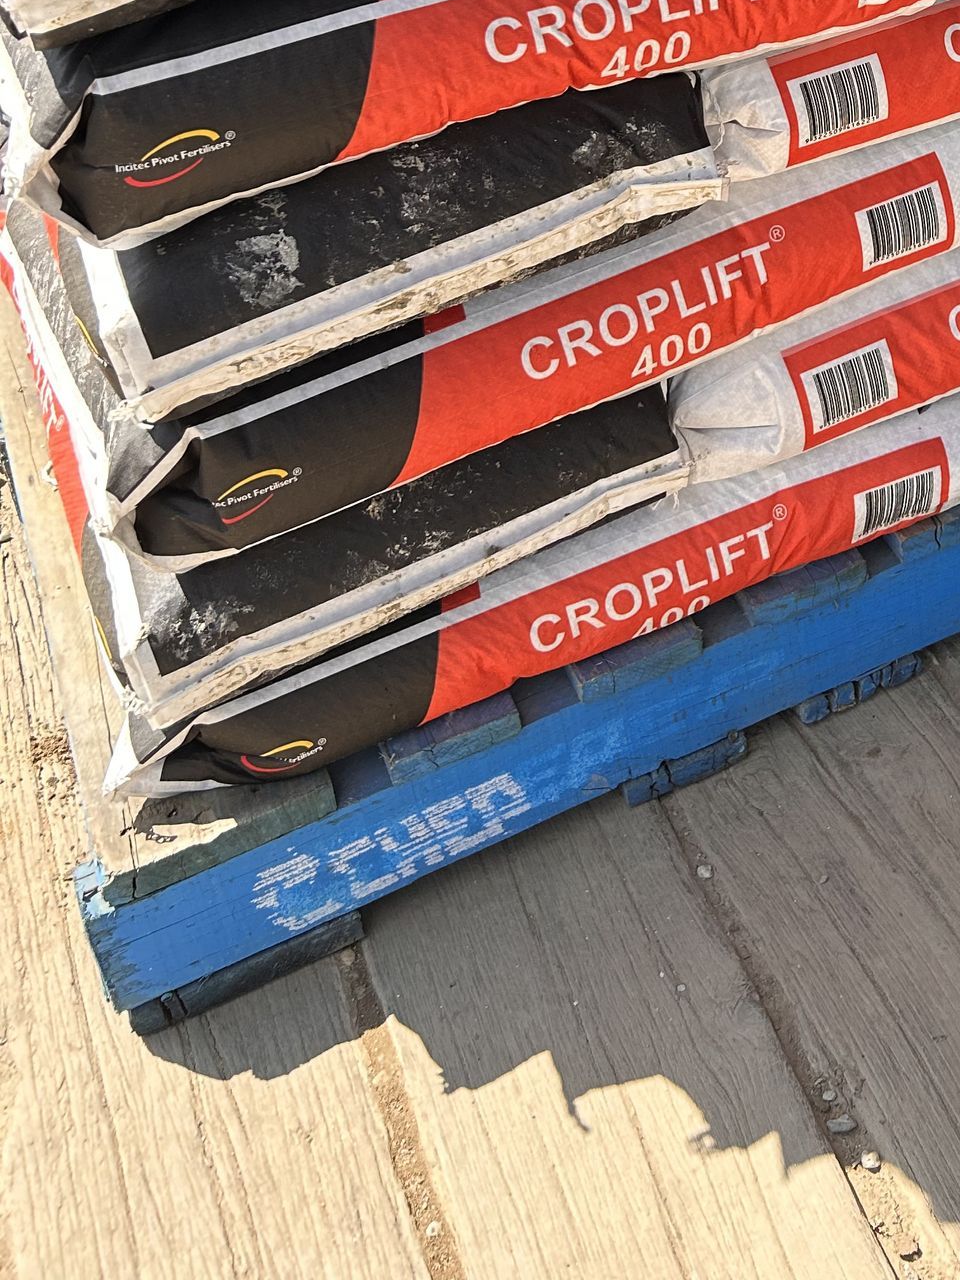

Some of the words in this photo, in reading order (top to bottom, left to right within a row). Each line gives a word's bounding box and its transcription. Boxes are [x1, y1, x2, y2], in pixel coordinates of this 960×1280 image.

[602, 30, 690, 83] 400
[115, 161, 150, 173] Incitec
[151, 153, 180, 168] Pivot
[629, 320, 712, 379] 400
[227, 492, 252, 506] Pivot
